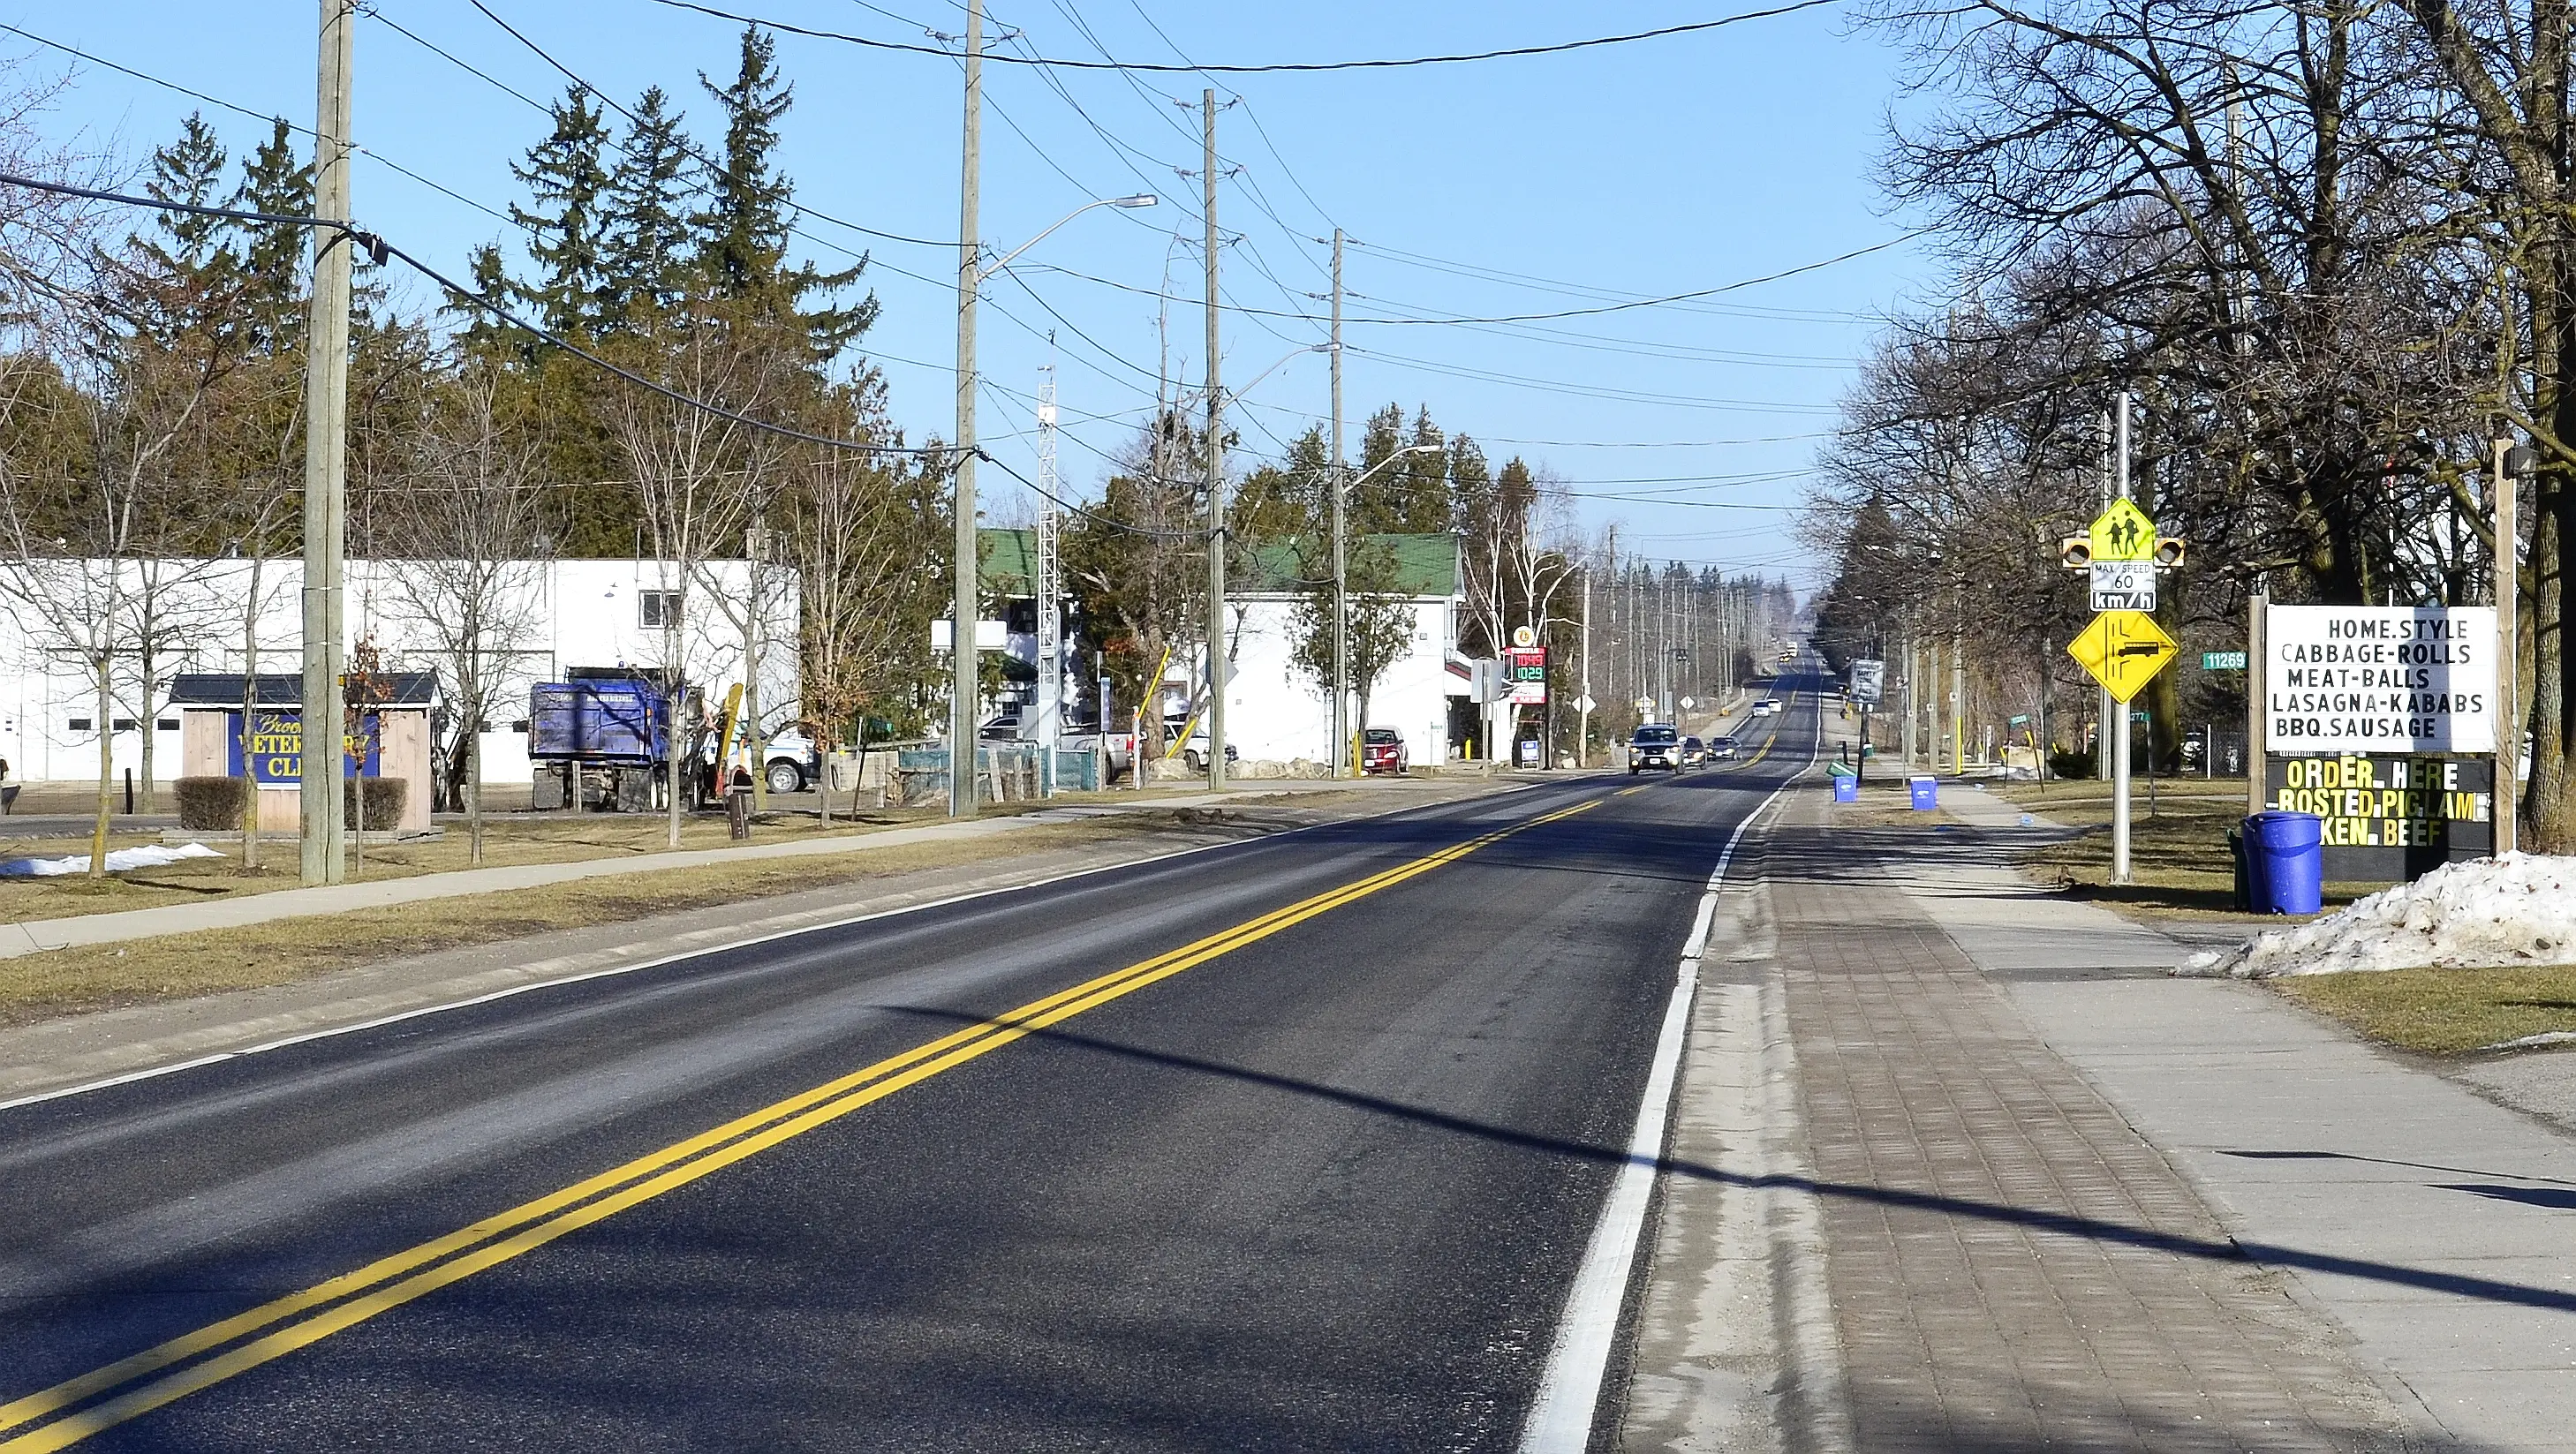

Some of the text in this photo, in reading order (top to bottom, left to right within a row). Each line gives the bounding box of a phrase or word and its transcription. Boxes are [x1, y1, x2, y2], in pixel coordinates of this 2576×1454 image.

[2122, 564, 2150, 574] SPEED
[2115, 576, 2134, 589] 60
[2095, 592, 2151, 609] km/h
[2329, 620, 2467, 639] HOME.STYLE
[2208, 652, 2245, 667] 11269
[2282, 644, 2471, 664] CABBAGE-ROLLS
[2287, 669, 2429, 689] MEAT-BALLS
[2272, 693, 2483, 713] LASAGNA-KABABS
[2276, 718, 2436, 738] BBQ.SAUSAGE
[2391, 761, 2459, 790] HERE
[2384, 818, 2441, 847] BEEF
